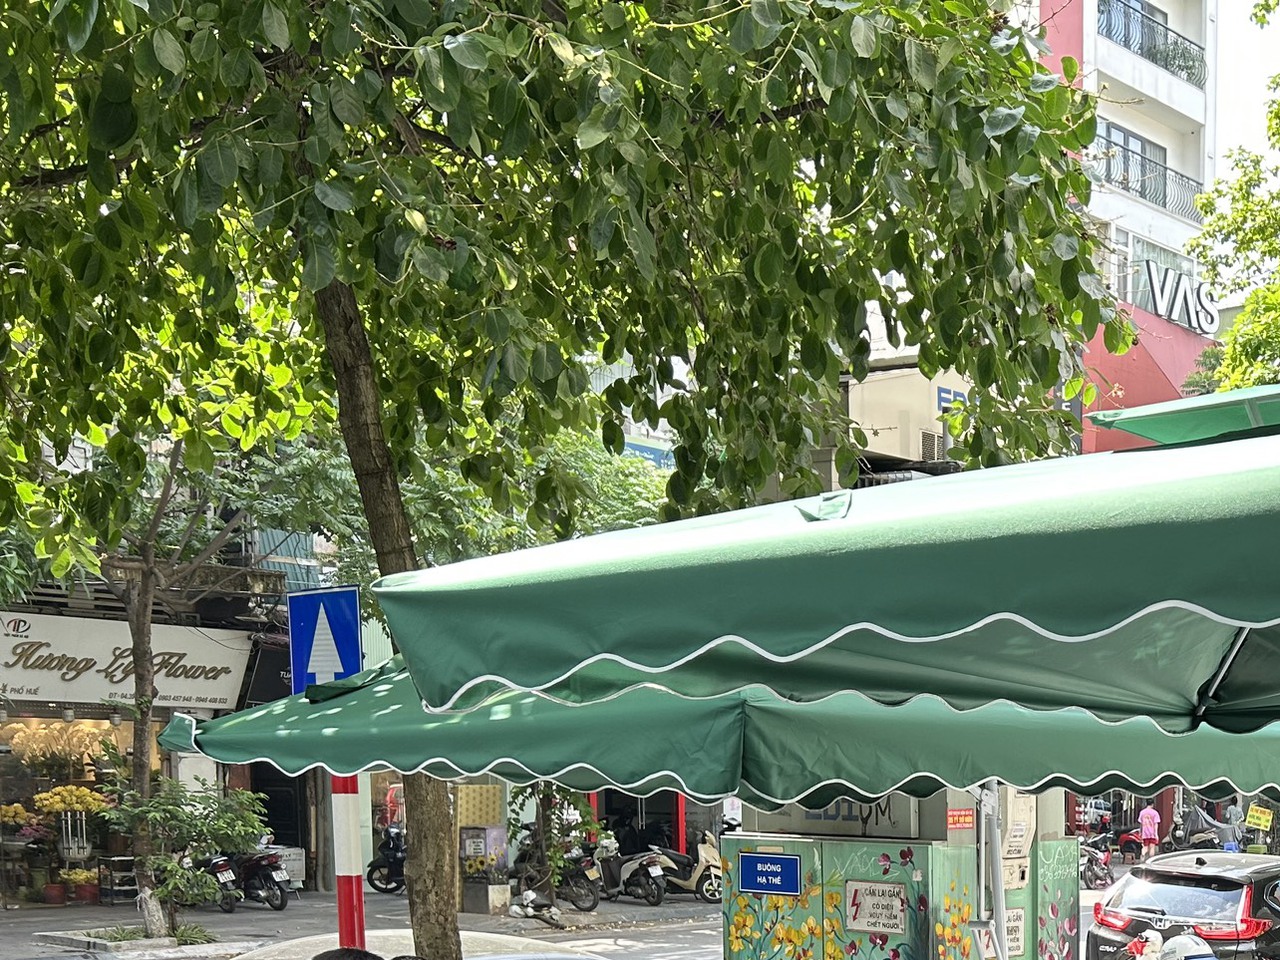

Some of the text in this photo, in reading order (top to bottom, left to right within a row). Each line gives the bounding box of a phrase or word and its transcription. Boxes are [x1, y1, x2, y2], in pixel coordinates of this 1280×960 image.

[1145, 259, 1220, 334] VAS
[1, 640, 97, 682] Hương
[151, 651, 232, 681] Flower
